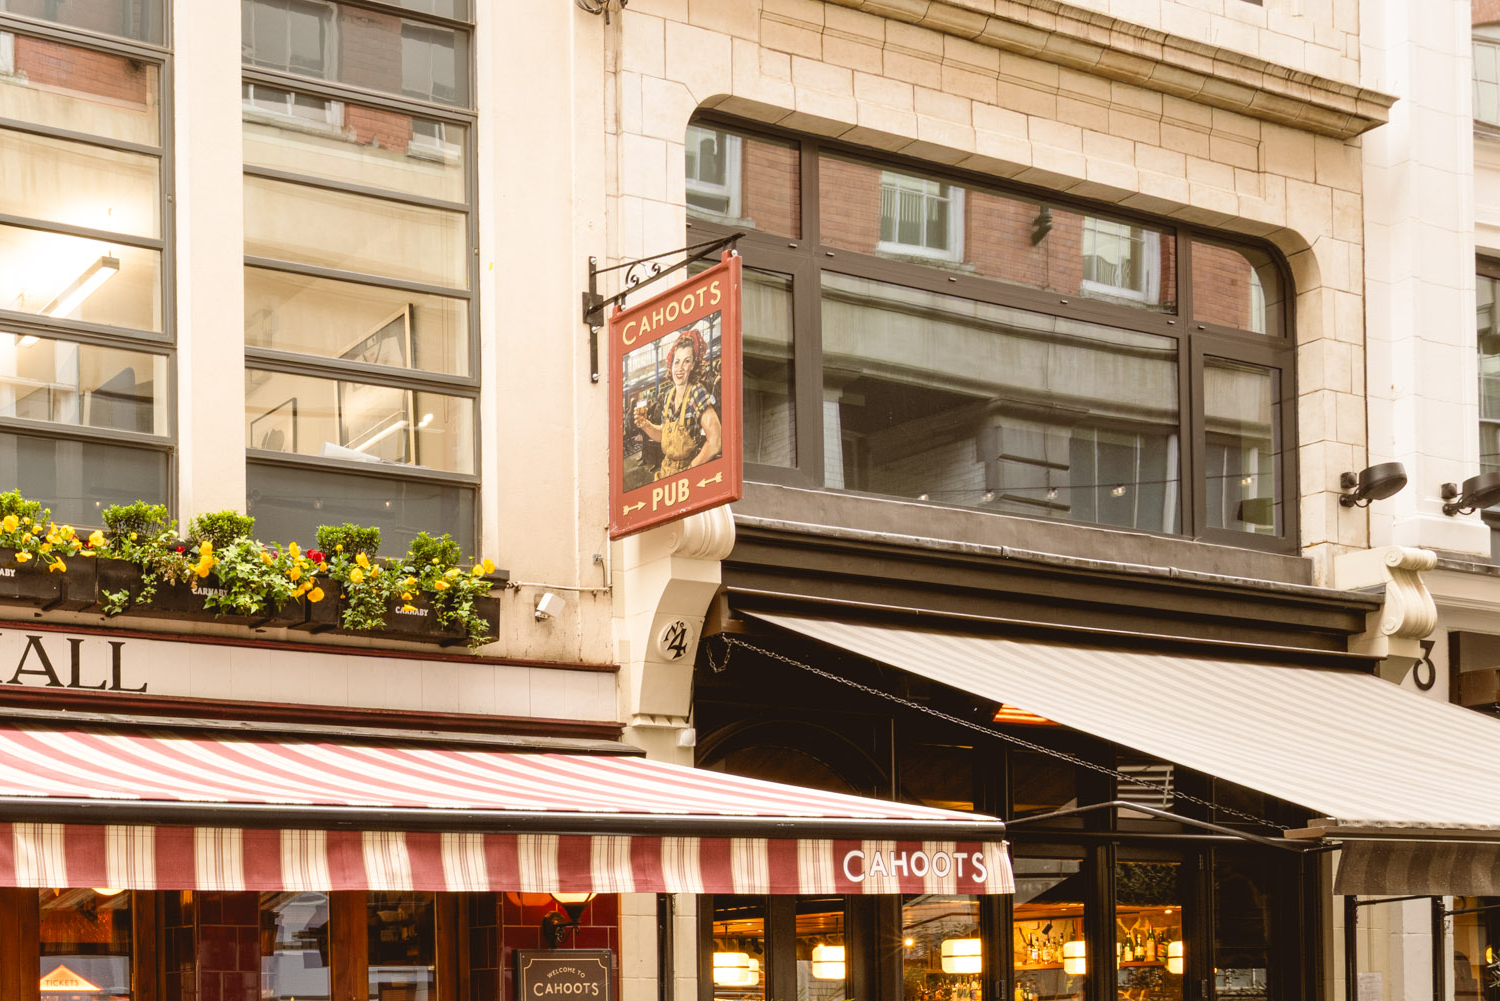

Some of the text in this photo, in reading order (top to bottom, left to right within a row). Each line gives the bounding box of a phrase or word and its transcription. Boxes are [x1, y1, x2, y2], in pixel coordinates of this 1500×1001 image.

[622, 280, 722, 346] CAHOOTS
[652, 477, 690, 512] PUB
[666, 628, 688, 660] 4
[1412, 639, 1436, 691] 3
[843, 850, 988, 883] CAHOOTS
[45, 979, 80, 987] TICKETS
[547, 966, 586, 979] WELCOME TO
[533, 982, 599, 997] CAHOOTS
